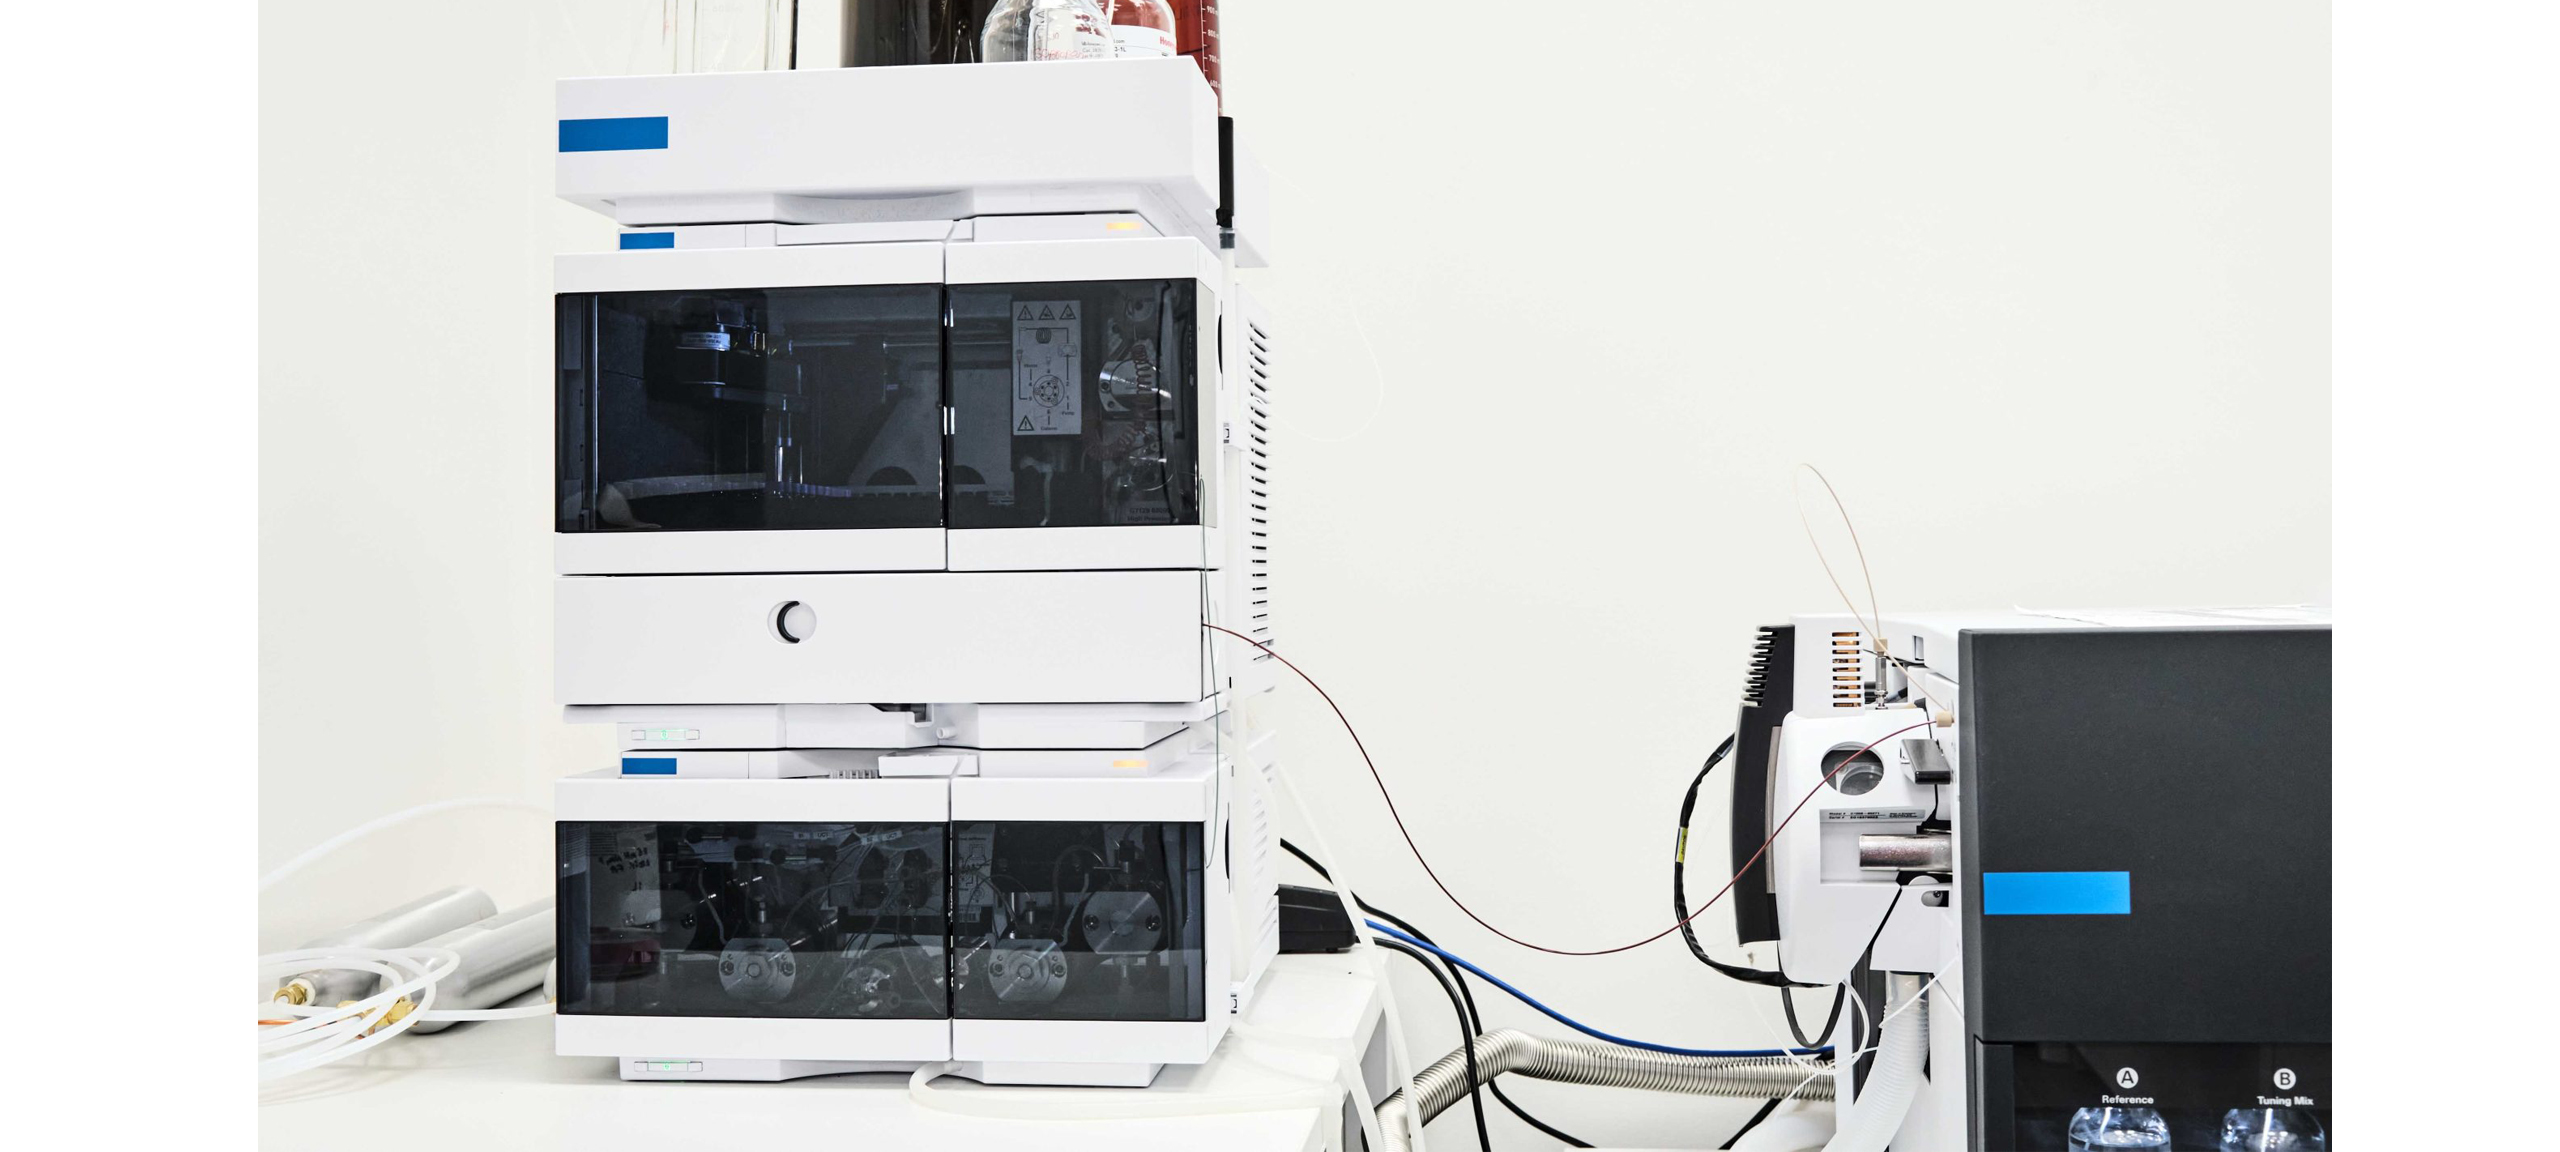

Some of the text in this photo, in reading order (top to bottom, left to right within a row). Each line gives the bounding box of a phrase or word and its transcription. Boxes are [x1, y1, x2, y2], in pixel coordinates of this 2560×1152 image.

[2121, 1071, 2134, 1084] A
[2280, 1072, 2291, 1086] B
[2102, 1095, 2154, 1105] Reference
[2257, 1096, 2314, 1107] Tuning Mix
